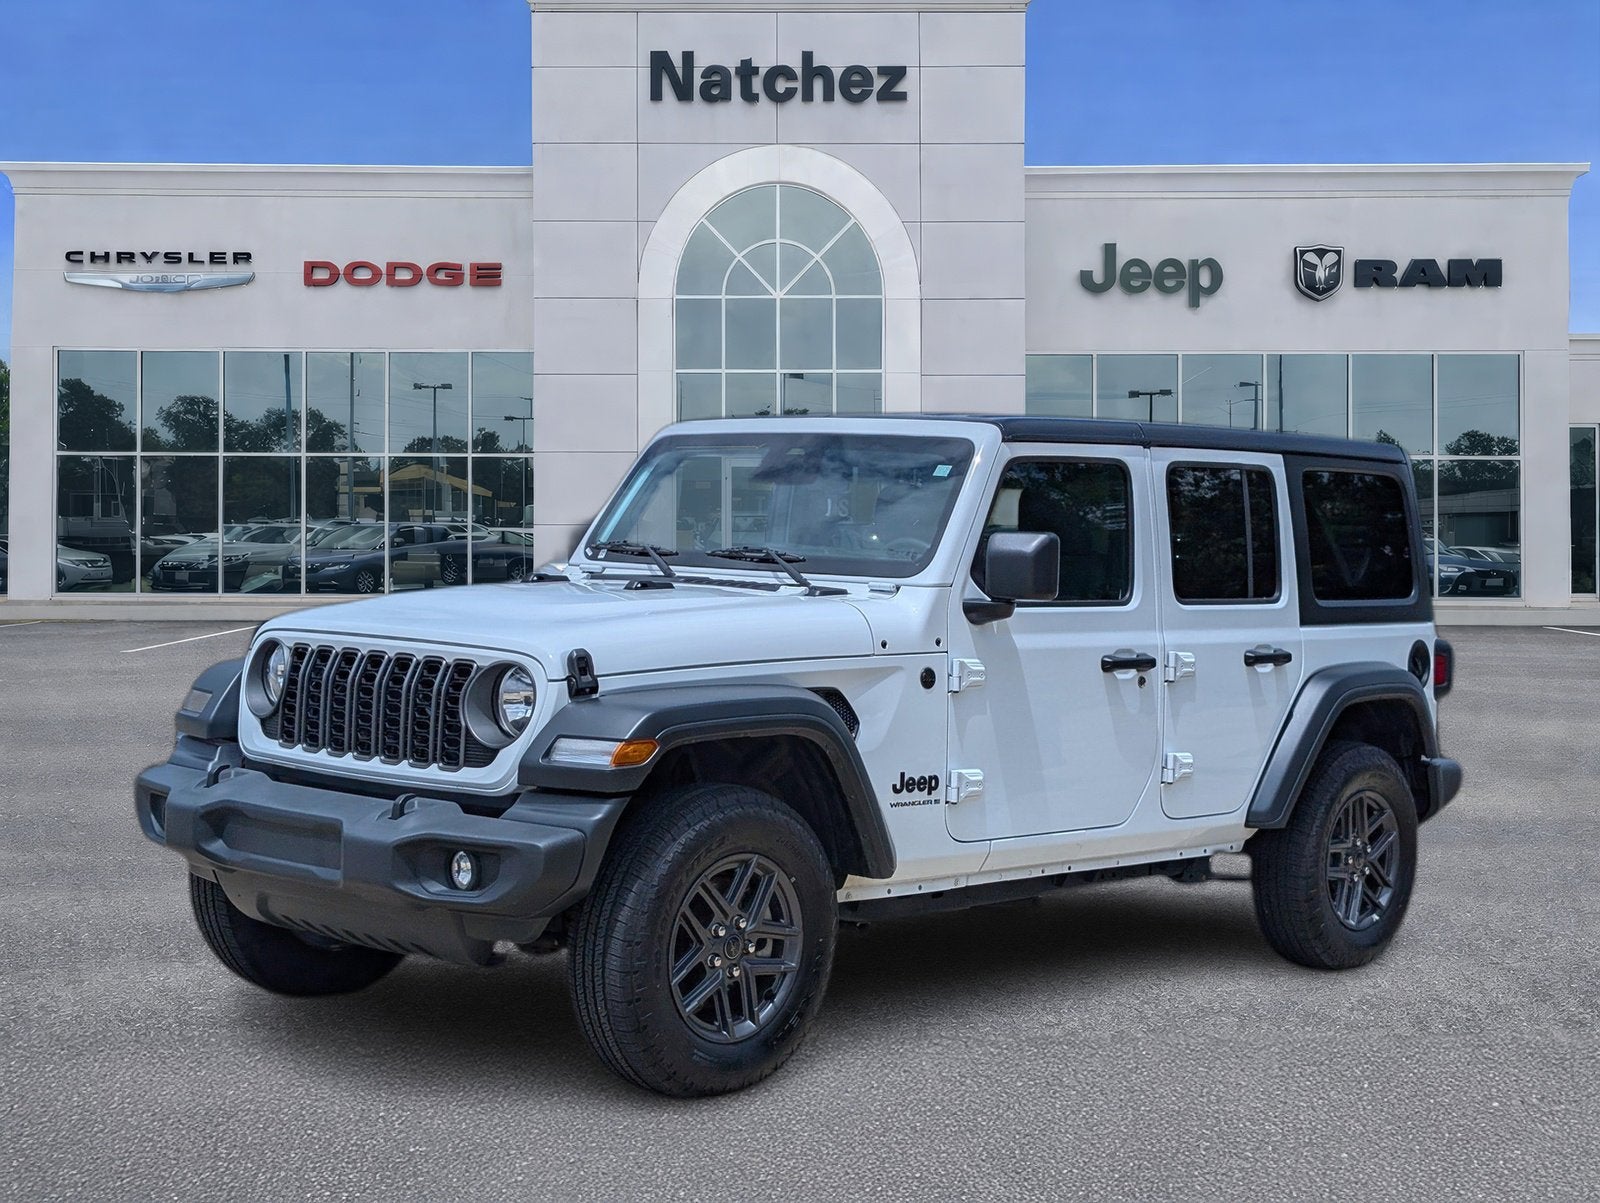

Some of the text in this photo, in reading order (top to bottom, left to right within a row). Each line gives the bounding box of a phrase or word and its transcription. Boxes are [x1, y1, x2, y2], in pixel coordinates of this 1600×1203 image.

[649, 50, 908, 104] Natchez
[64, 250, 253, 265] CHRYSLER
[303, 260, 503, 287] DODGE
[1079, 242, 1224, 308] Jeep
[1353, 258, 1503, 288] RAM
[891, 771, 940, 796] Jeep
[889, 799, 933, 808] WRANGLER
